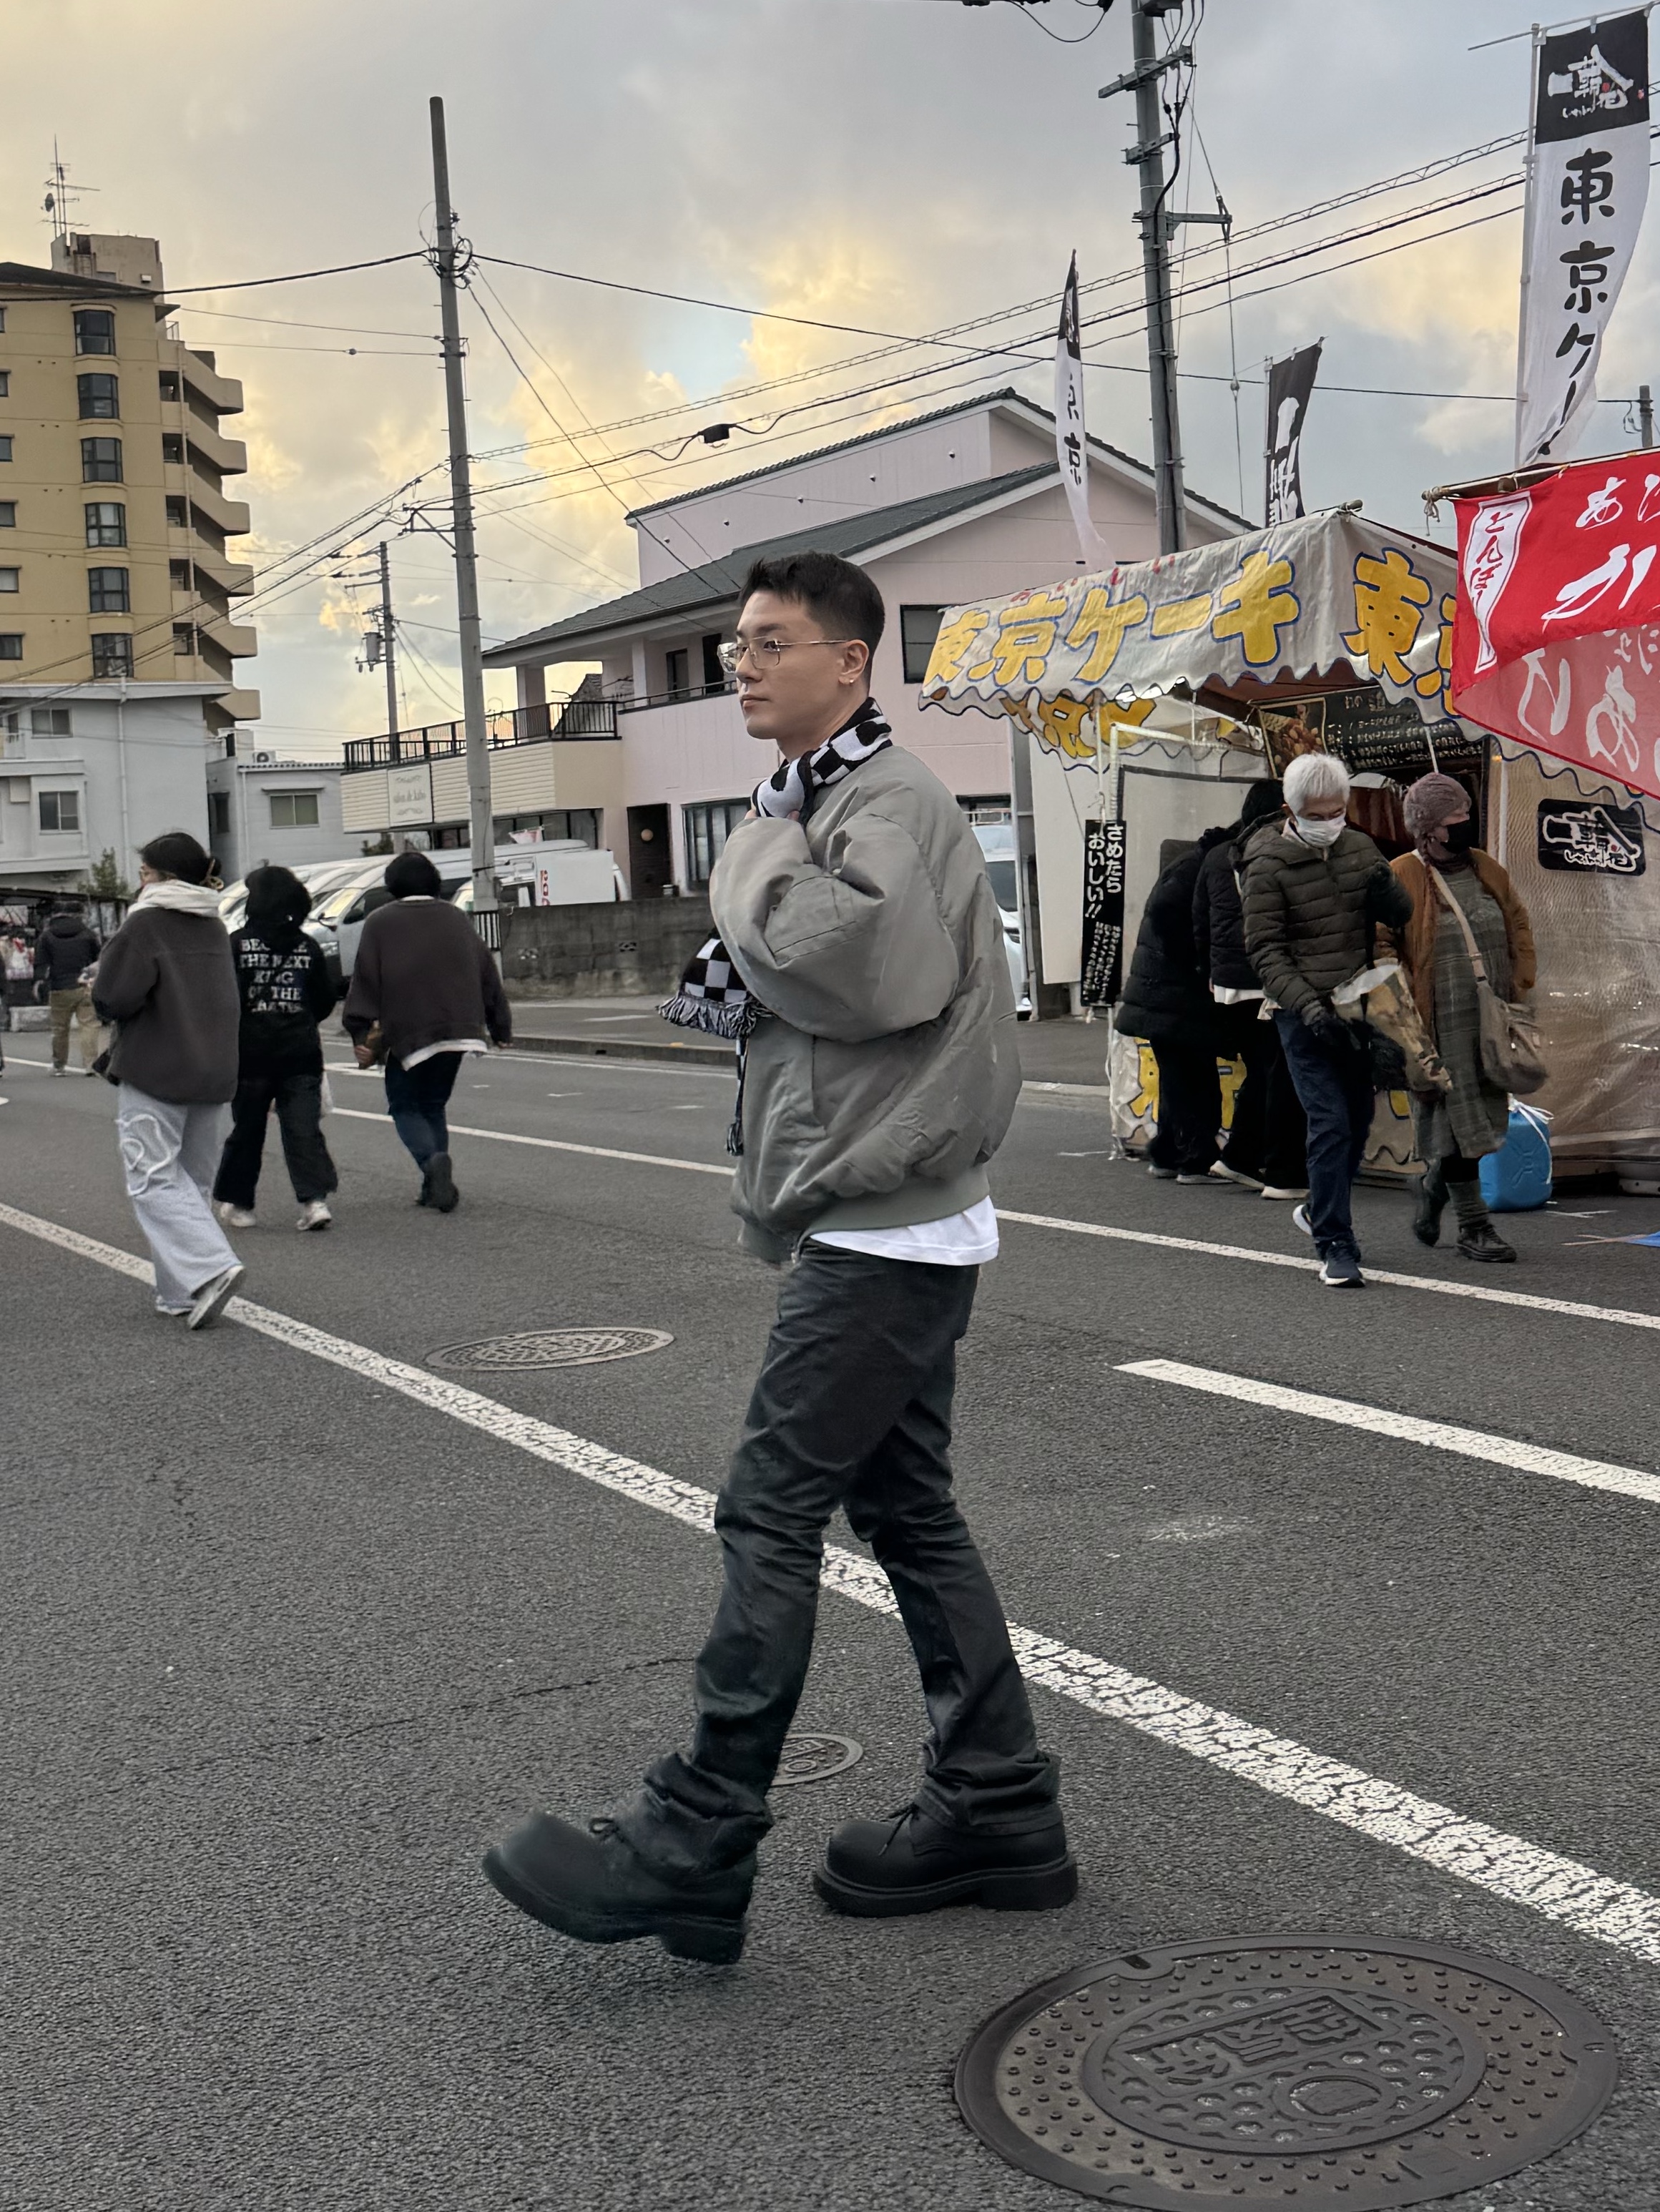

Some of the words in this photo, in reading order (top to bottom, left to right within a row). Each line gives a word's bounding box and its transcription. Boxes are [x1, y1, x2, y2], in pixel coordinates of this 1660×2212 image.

[923, 547, 1301, 687] 東京ケーキ
[1105, 825, 1124, 893] さめたら
